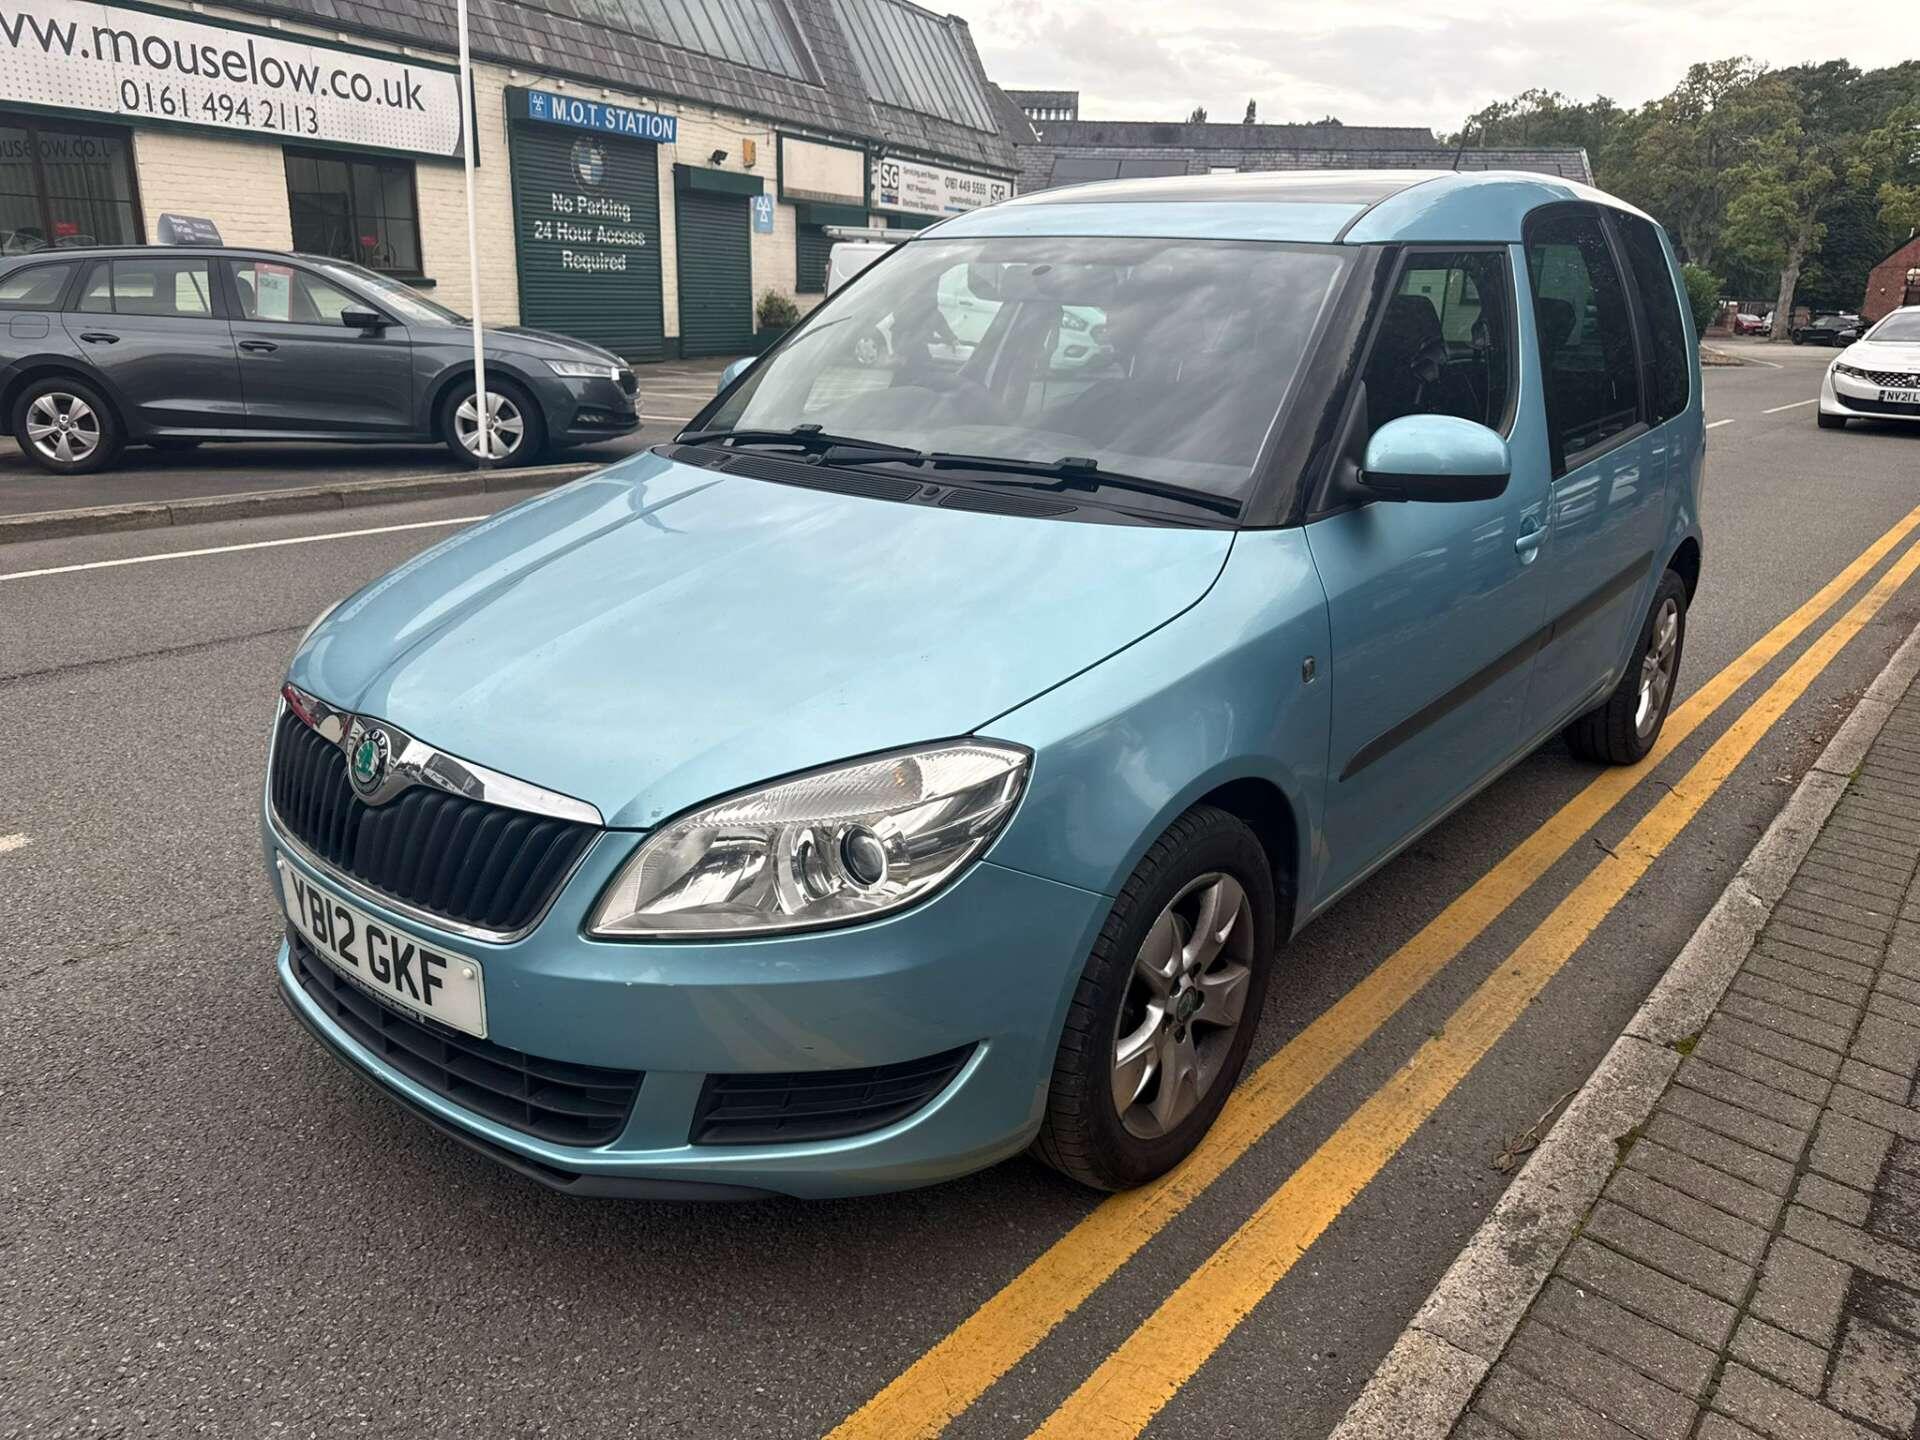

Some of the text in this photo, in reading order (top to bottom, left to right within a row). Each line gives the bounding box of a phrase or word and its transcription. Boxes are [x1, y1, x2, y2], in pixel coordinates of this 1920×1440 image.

[120, 78, 319, 134] 0161 494 2113
[551, 96, 674, 139] M.O.T. STATION
[881, 164, 899, 189] SG
[944, 176, 958, 190] 0161
[959, 179, 971, 192] 449
[551, 192, 632, 223] No Parking
[534, 220, 647, 246] 24 Hour Access
[562, 250, 627, 273] Required
[290, 872, 359, 967] YB12
[366, 924, 447, 1006] GKF
